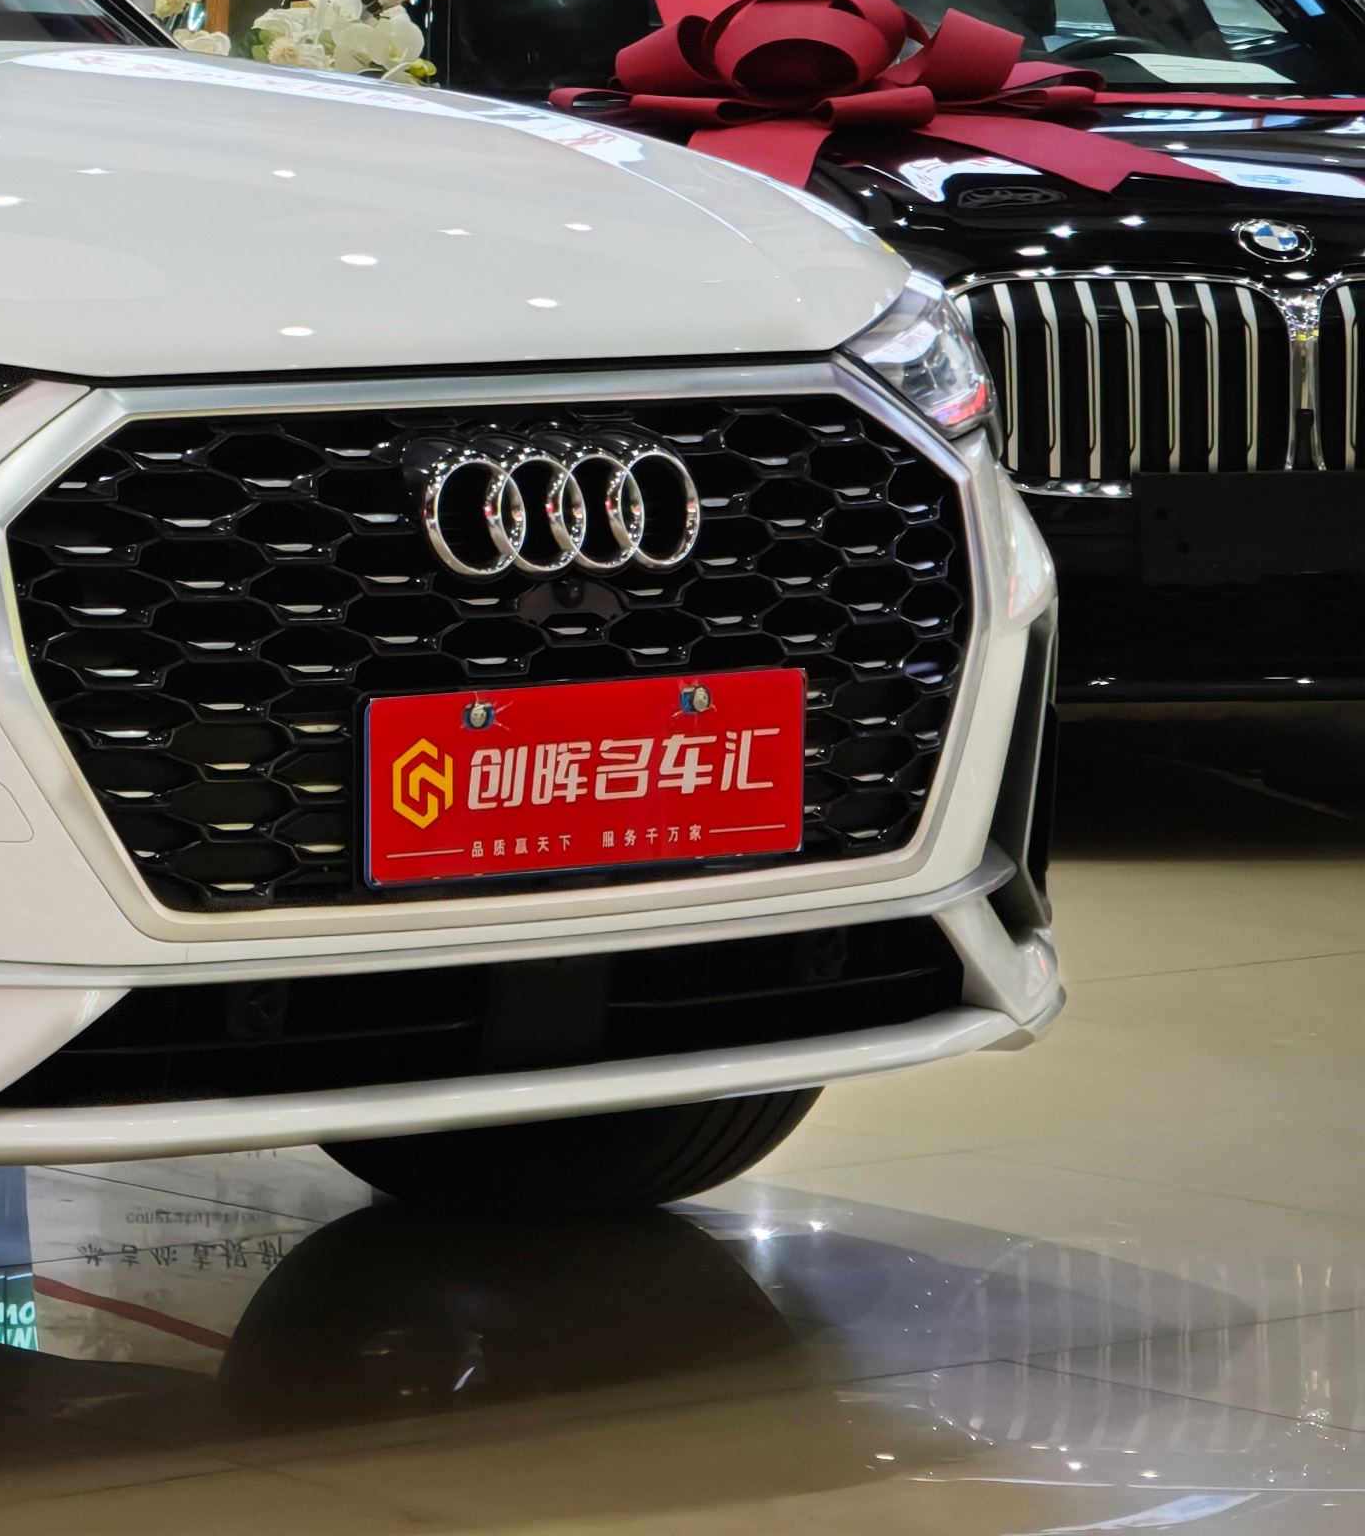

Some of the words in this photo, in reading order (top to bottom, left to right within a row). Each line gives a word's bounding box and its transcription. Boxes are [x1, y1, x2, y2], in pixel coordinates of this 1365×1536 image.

[467, 727, 780, 810] 创晖名车汇
[471, 834, 572, 859] 品质赢天下
[602, 824, 703, 849] 服务千万家
